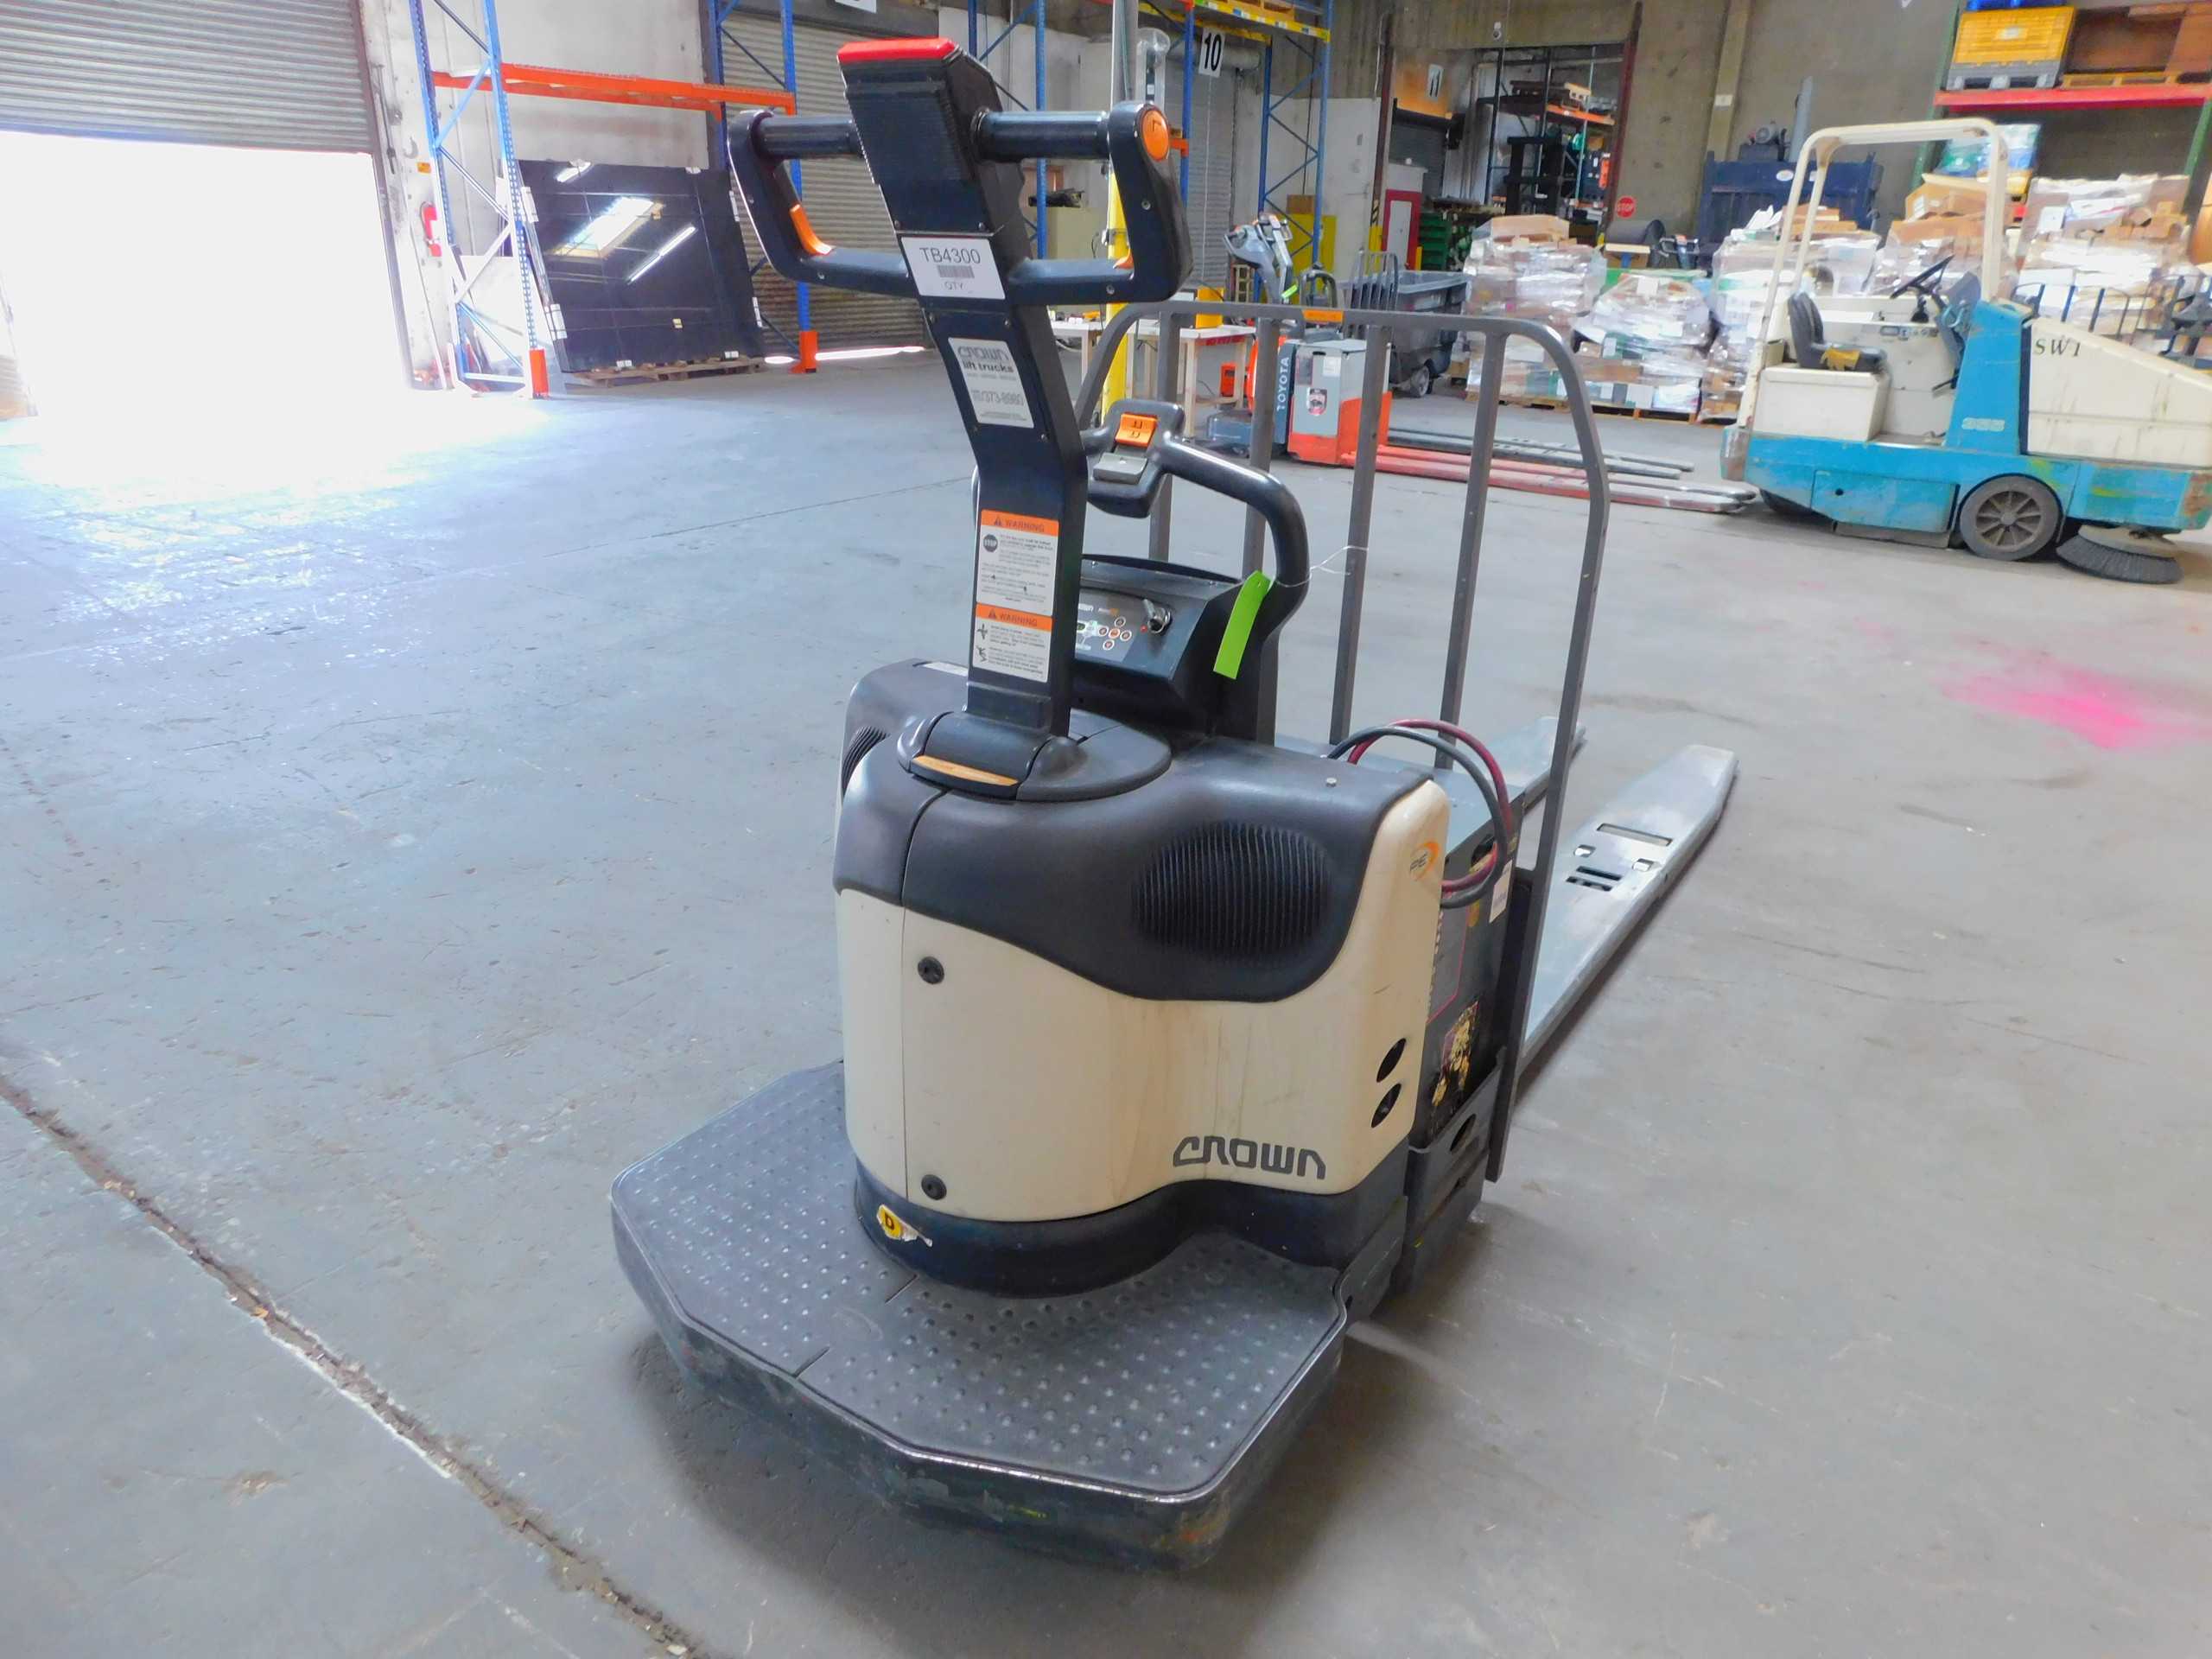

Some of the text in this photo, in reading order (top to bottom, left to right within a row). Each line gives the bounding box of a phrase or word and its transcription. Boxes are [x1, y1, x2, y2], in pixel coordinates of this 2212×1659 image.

[1205, 33, 1222, 71] 10
[919, 247, 981, 264] TB4300
[2034, 337, 2082, 357] SW1
[979, 362, 1014, 373] trucks
[1277, 357, 1289, 411] TOYOTA
[1007, 518, 1045, 533] WARNING
[1001, 613, 1038, 626] WARNING
[1173, 1135, 1326, 1180] CROWN
